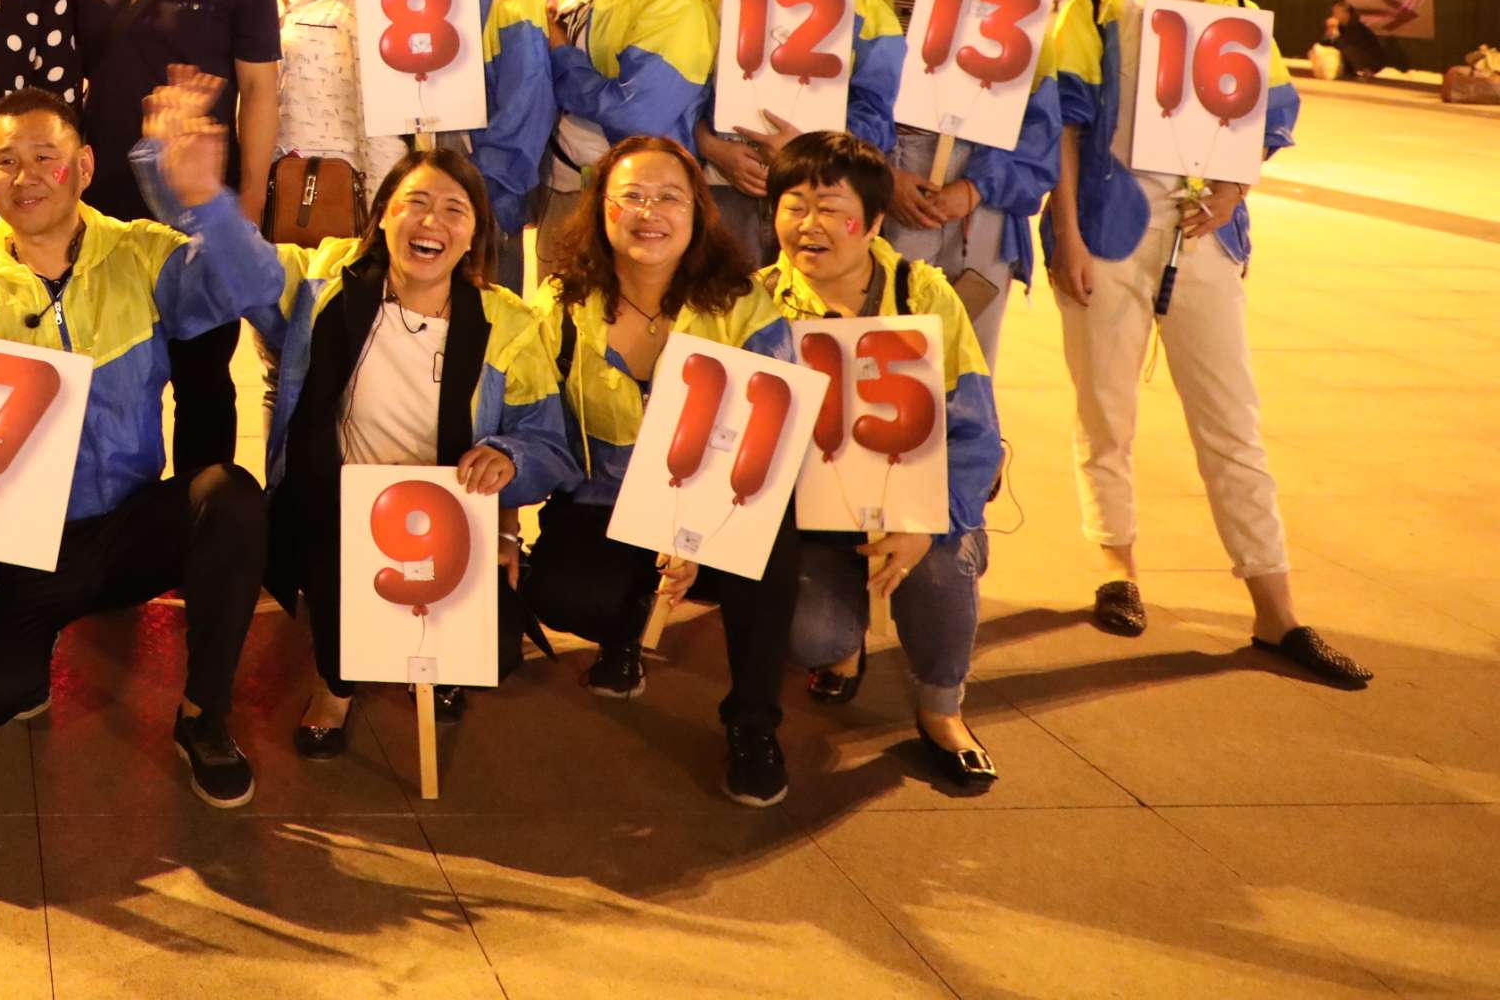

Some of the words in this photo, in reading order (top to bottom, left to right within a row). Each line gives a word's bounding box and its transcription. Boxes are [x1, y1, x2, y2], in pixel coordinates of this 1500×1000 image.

[1151, 9, 1262, 118] 16
[667, 352, 792, 499] 11
[801, 328, 937, 462] 15
[370, 479, 472, 608] 9
